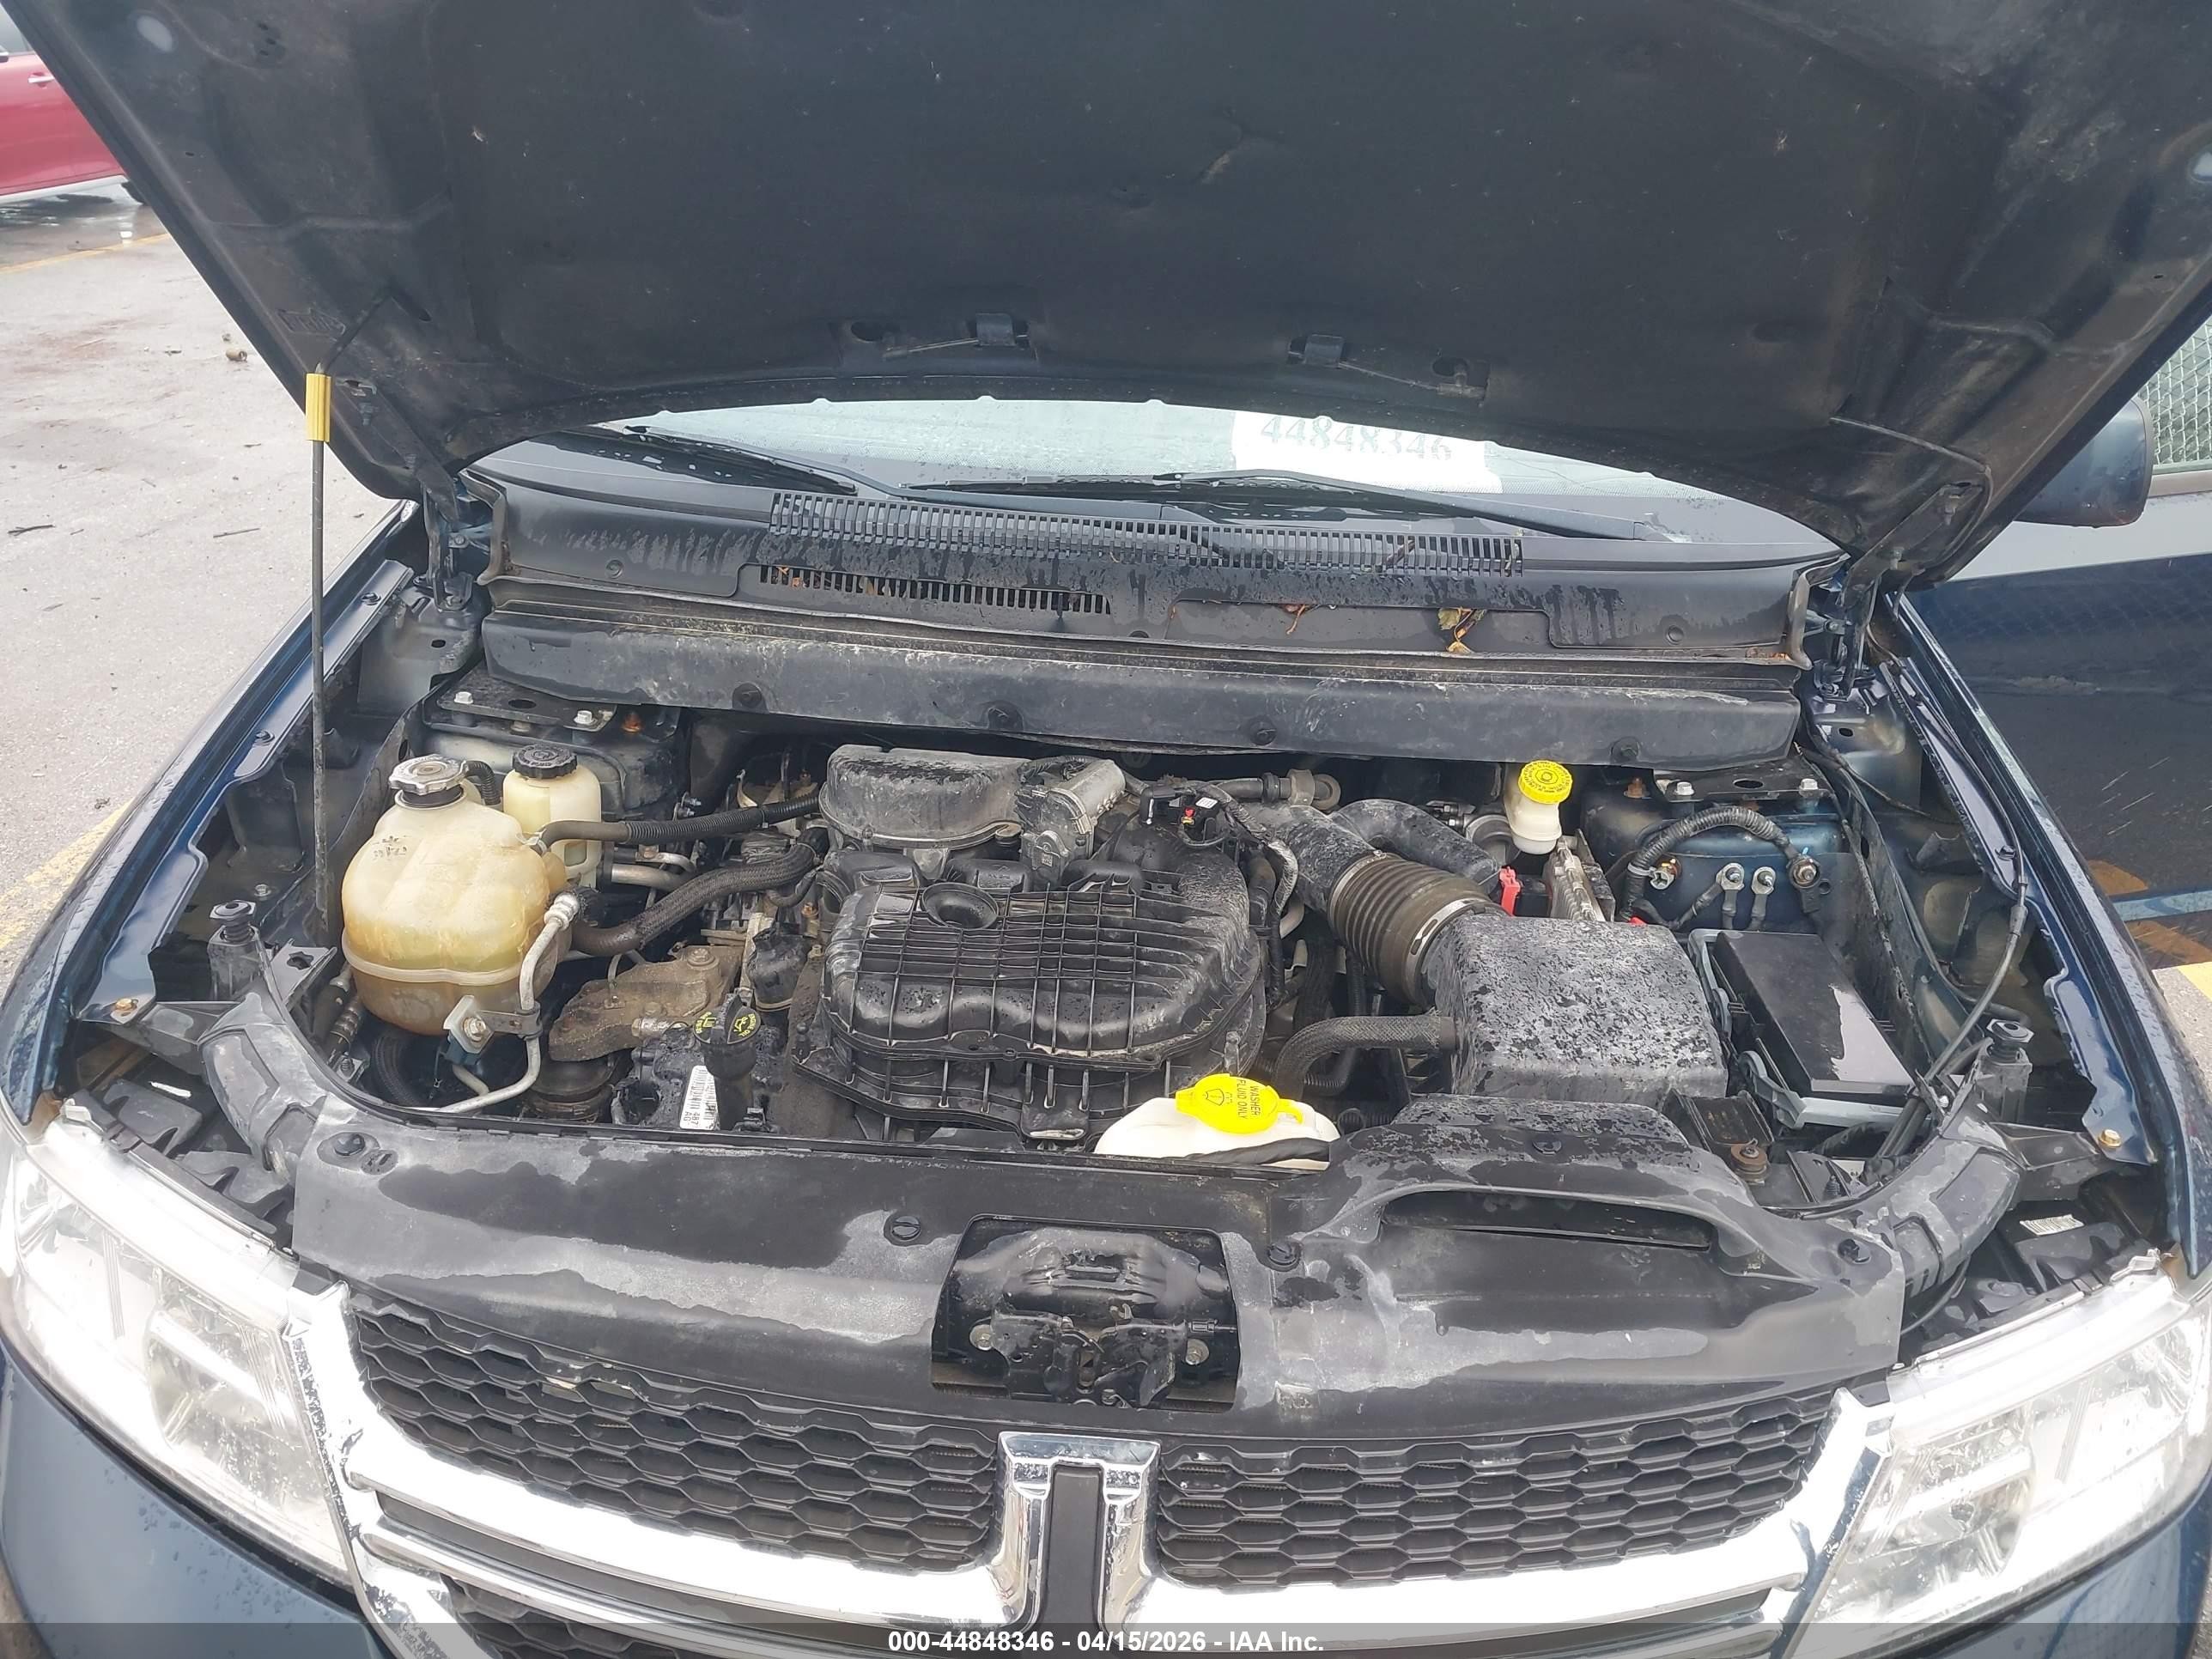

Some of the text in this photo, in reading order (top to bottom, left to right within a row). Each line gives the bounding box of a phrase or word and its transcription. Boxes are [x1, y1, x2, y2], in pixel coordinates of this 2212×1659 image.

[1261, 416, 1451, 460] 44848346
[1237, 1079, 1248, 1119] FLUID ONLY
[1250, 1086, 1261, 1115] WASHER
